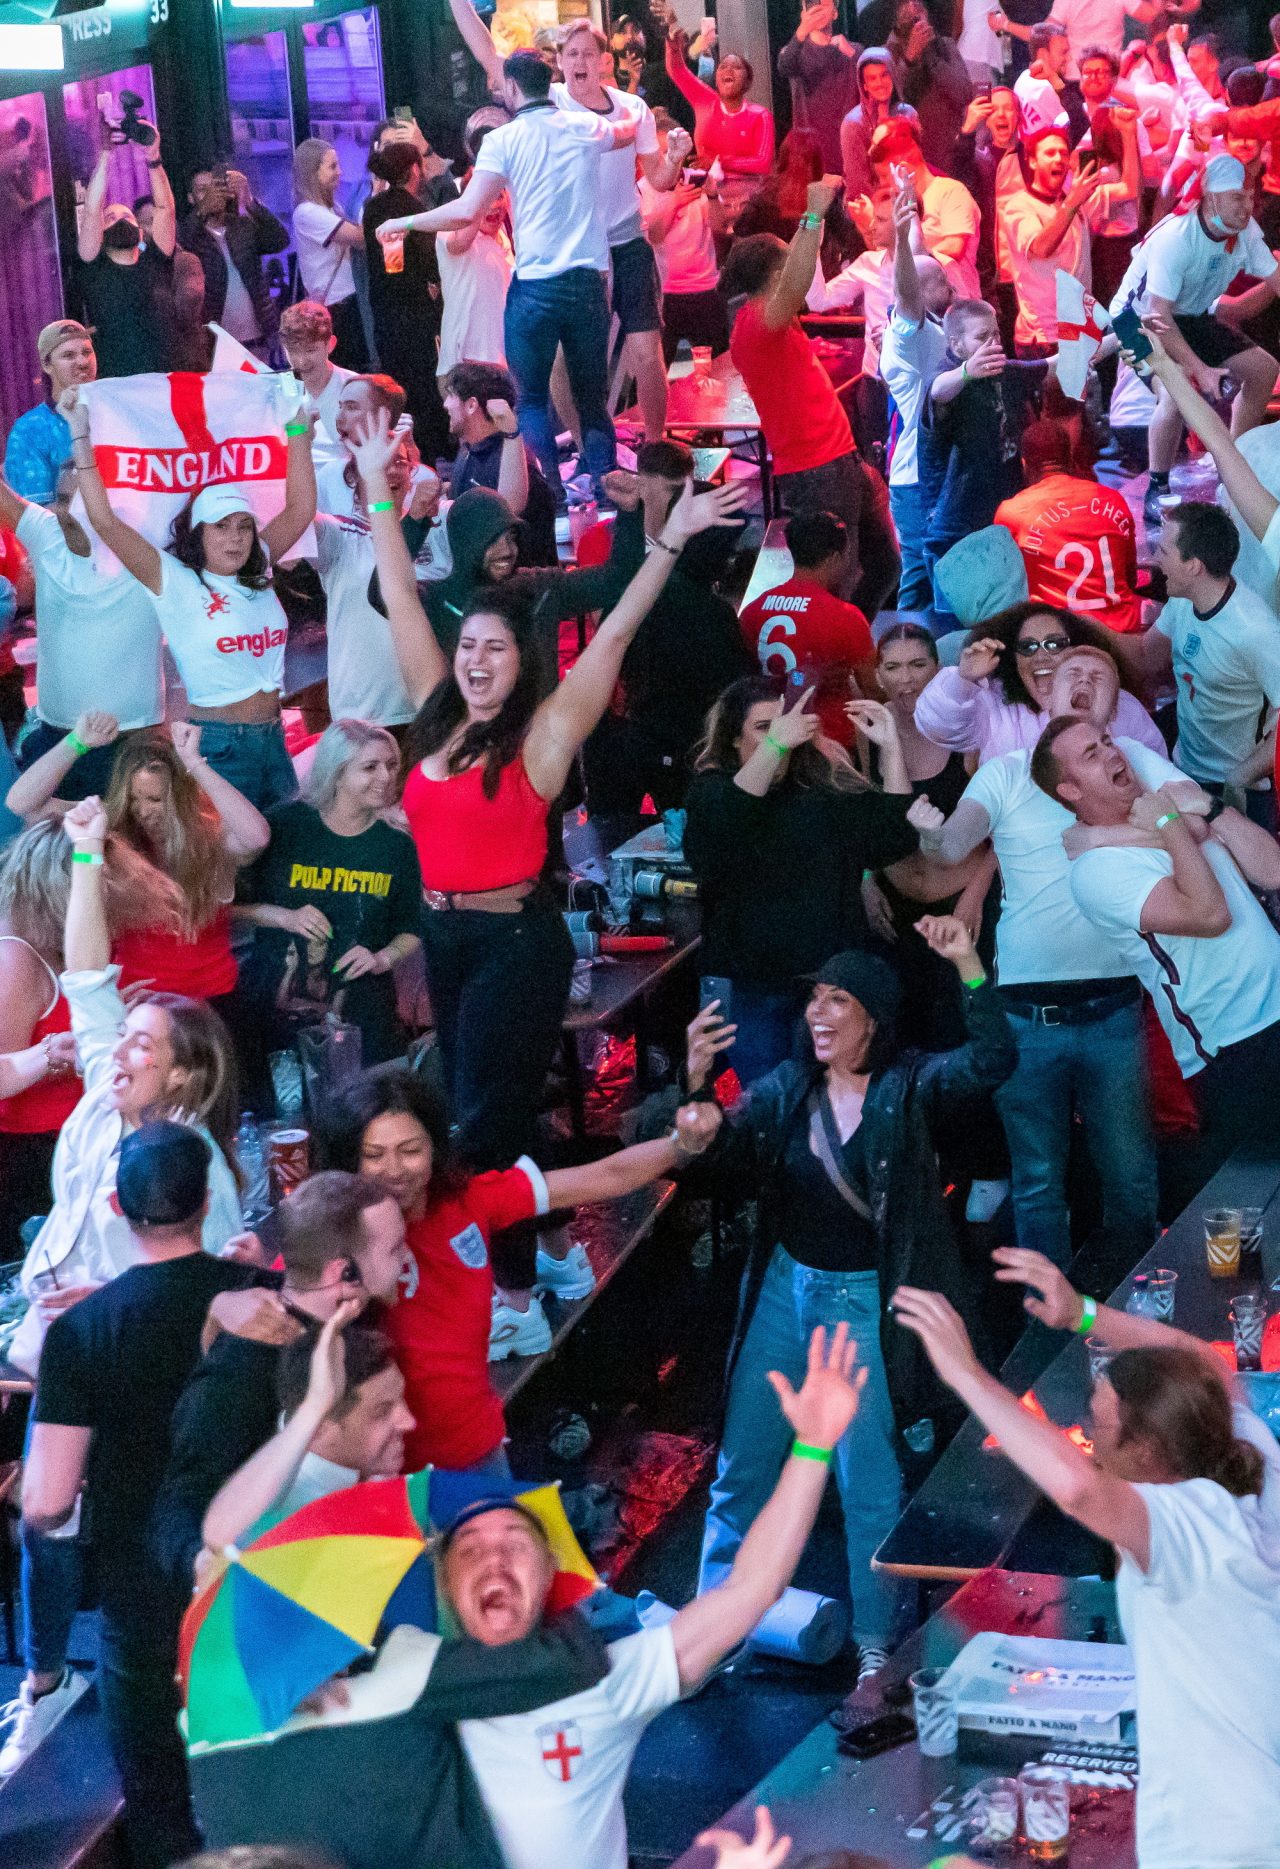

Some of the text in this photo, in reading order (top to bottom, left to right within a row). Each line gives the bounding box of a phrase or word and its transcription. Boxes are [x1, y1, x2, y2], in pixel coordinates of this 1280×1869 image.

[1054, 535, 1121, 611] 21
[761, 595, 812, 612] MOORE
[757, 614, 797, 677] 6
[289, 863, 393, 896] PULP FICTION
[1041, 1751, 1139, 1772] RESERVED
